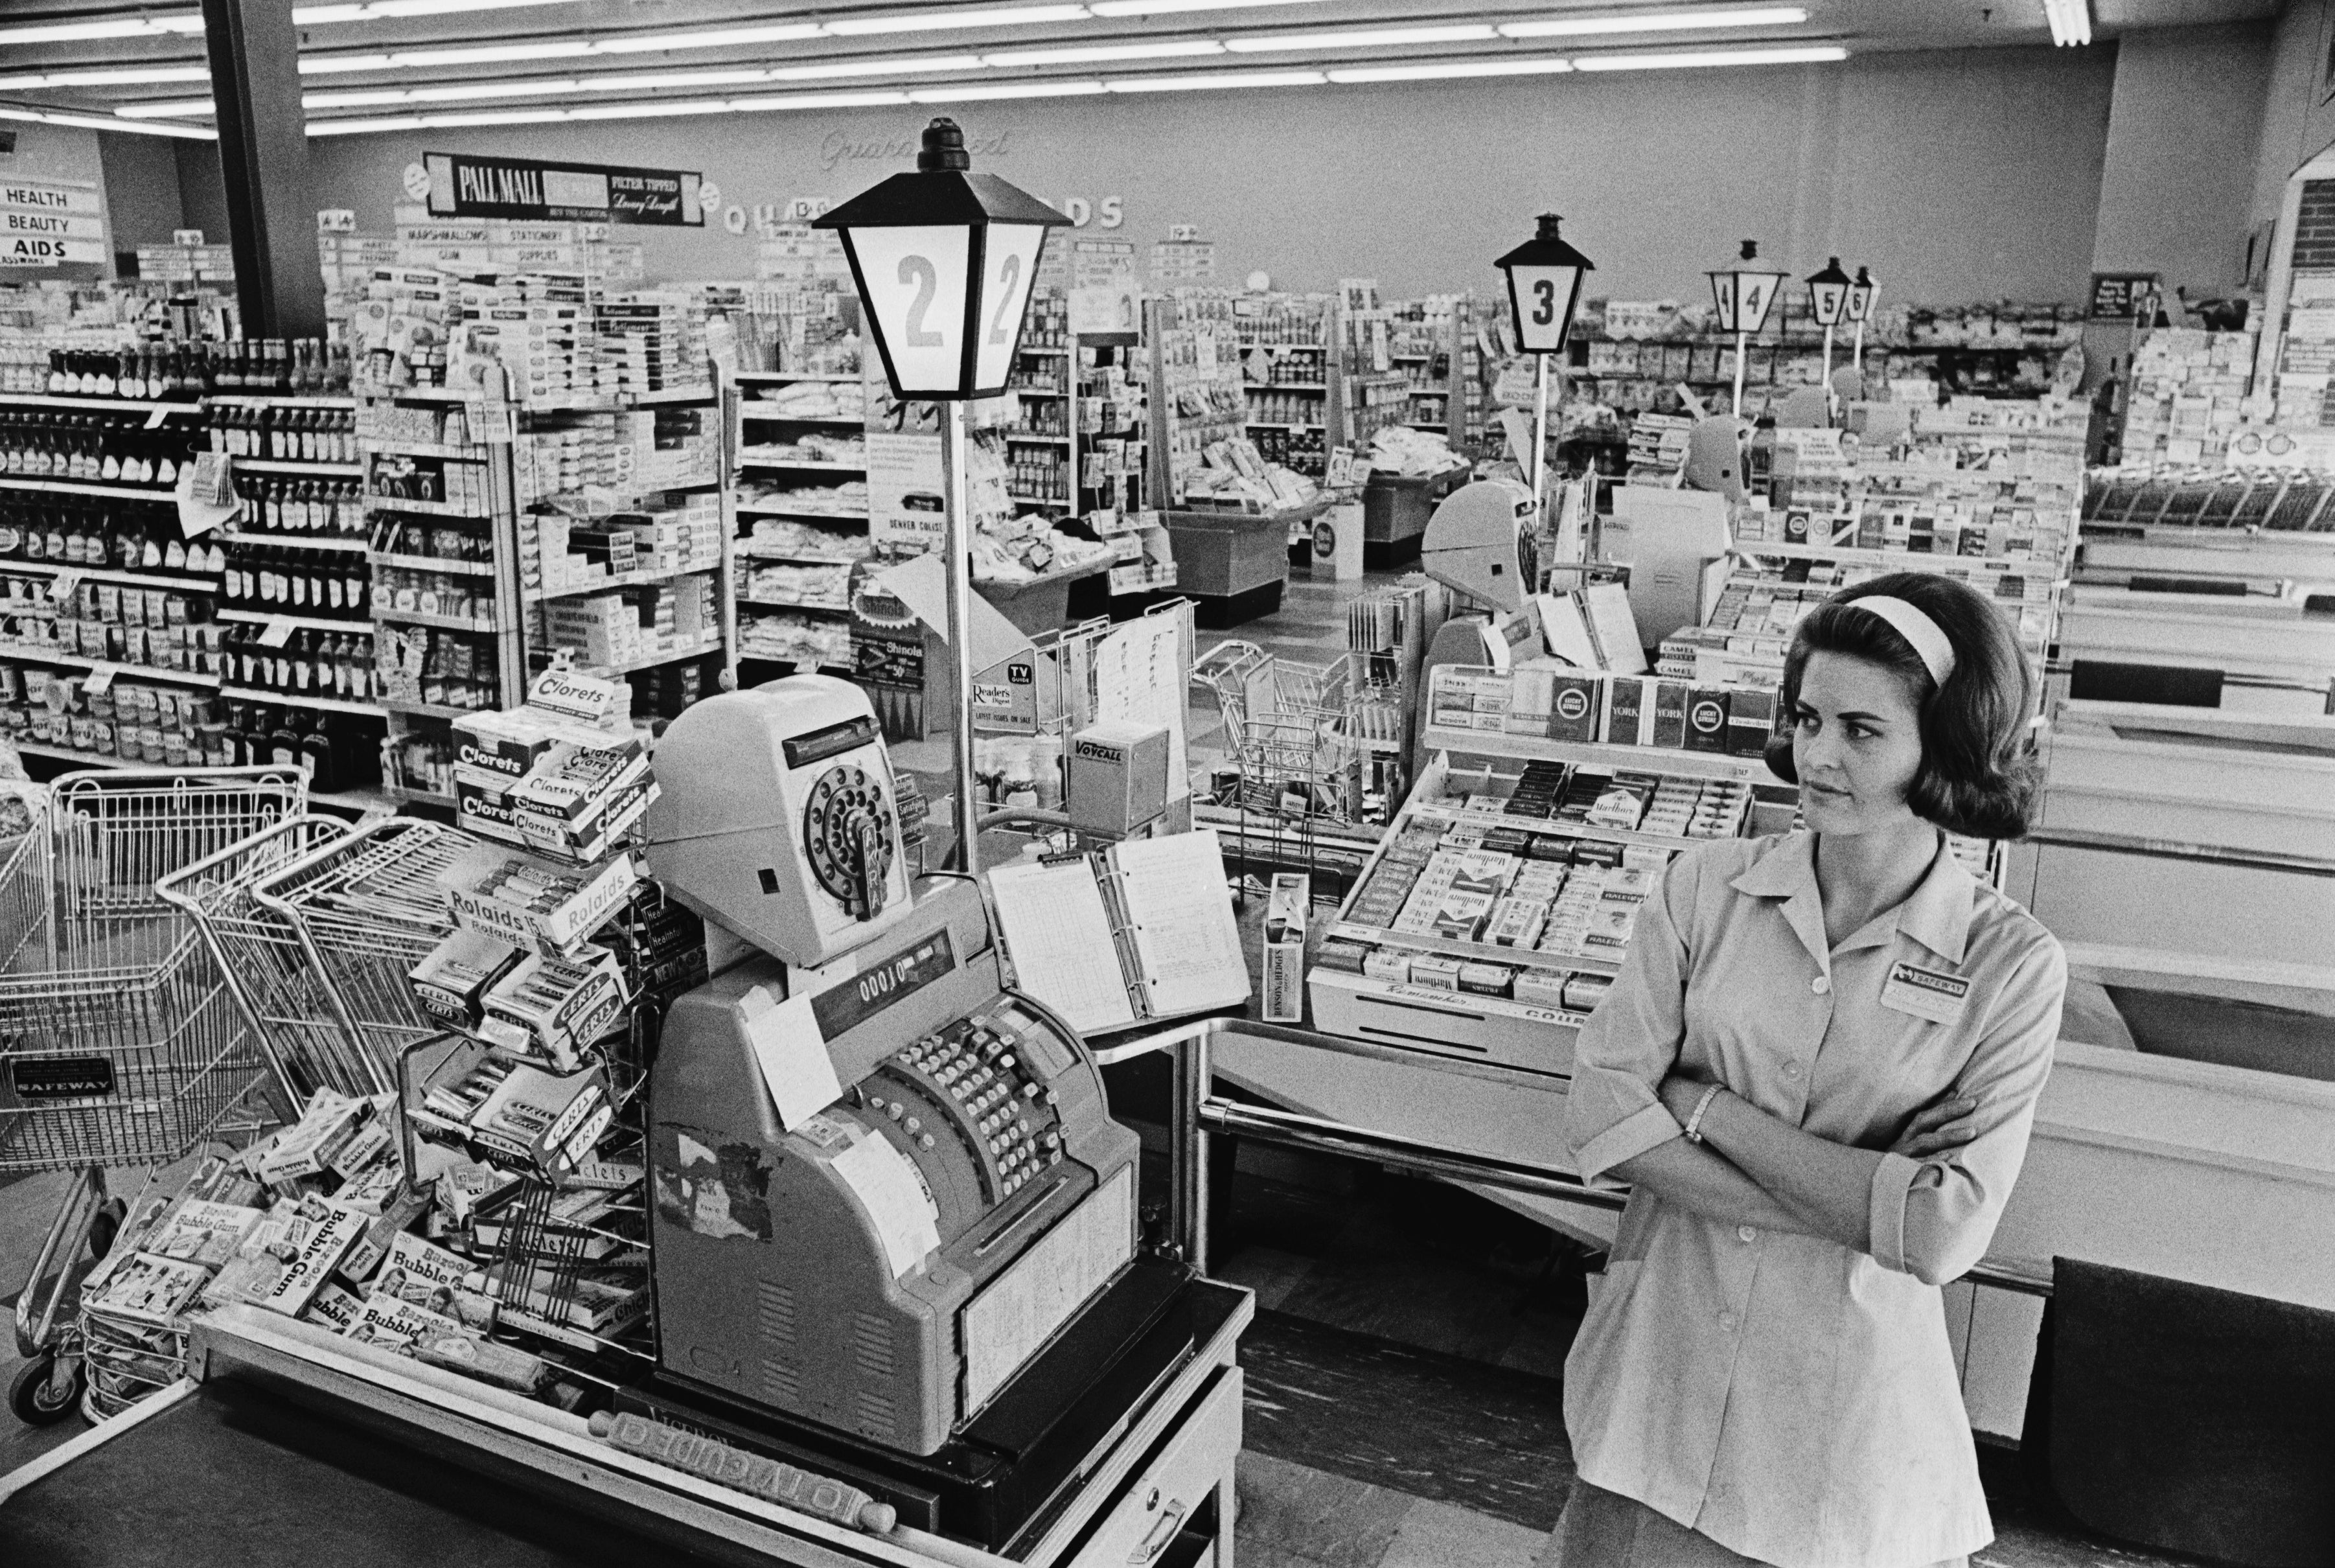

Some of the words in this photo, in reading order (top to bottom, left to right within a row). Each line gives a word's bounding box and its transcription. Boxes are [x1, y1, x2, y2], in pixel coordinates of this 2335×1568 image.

[459, 165, 498, 203] PALL
[498, 168, 542, 205] MALL
[611, 176, 643, 190] FILTER
[644, 178, 678, 192] TIPPED
[6, 189, 67, 207] HEALTH
[8, 215, 69, 232] BEAUTY
[14, 240, 66, 257] AIDS
[897, 255, 944, 347] 2
[988, 254, 1020, 345] 2
[1532, 280, 1555, 325] 3
[1721, 284, 1729, 314] 4
[1747, 285, 1760, 315] 4
[1824, 292, 1834, 314] 5
[1853, 292, 1861, 311] 6
[886, 641, 923, 657] Shinola
[1664, 645, 1694, 654] CAMEL
[1011, 665, 1028, 677] TV
[1661, 665, 1692, 675] CAMEL
[539, 678, 605, 703] Clorets
[973, 684, 1010, 703] Reader's
[993, 714, 1009, 722] ISSUES
[1613, 707, 1639, 717] YORK
[1657, 708, 1683, 719] YORK
[460, 744, 521, 773] Clorets
[1076, 741, 1121, 761] VOYCALL
[530, 778, 581, 796] Clorets
[584, 756, 628, 803] Clorets
[514, 797, 564, 816] Clorets
[596, 787, 640, 833] Clorets
[899, 799, 925, 815] Satisfying
[1596, 802, 1635, 815] Marlboro
[516, 814, 557, 836] Clorets
[1466, 853, 1506, 867] Marlboro
[451, 890, 523, 931] Rolaids
[569, 875, 625, 930] Rolaids
[1448, 894, 1486, 908] Marlboro
[472, 921, 526, 947] Rolaids
[1274, 950, 1283, 981] HEDGES
[1917, 975, 1962, 993] SAFEWAY
[421, 987, 457, 1005] CERTS
[561, 976, 601, 1022] CERTS
[1274, 989, 1283, 1017] BENSON
[426, 1002, 454, 1017] CERTS
[577, 998, 612, 1044] CERTS
[17, 1081, 109, 1091] SAFEWAY
[553, 1096, 589, 1140] CERTS
[363, 1135, 382, 1150] Gum
[176, 1214, 214, 1229] Bubble
[214, 1219, 240, 1232] Gum
[302, 1210, 347, 1260] Bubble
[300, 1236, 345, 1289] Bazooka
[393, 1250, 448, 1285] Bubble
[271, 1262, 308, 1297] Gum
[363, 1308, 424, 1339] Bubble
